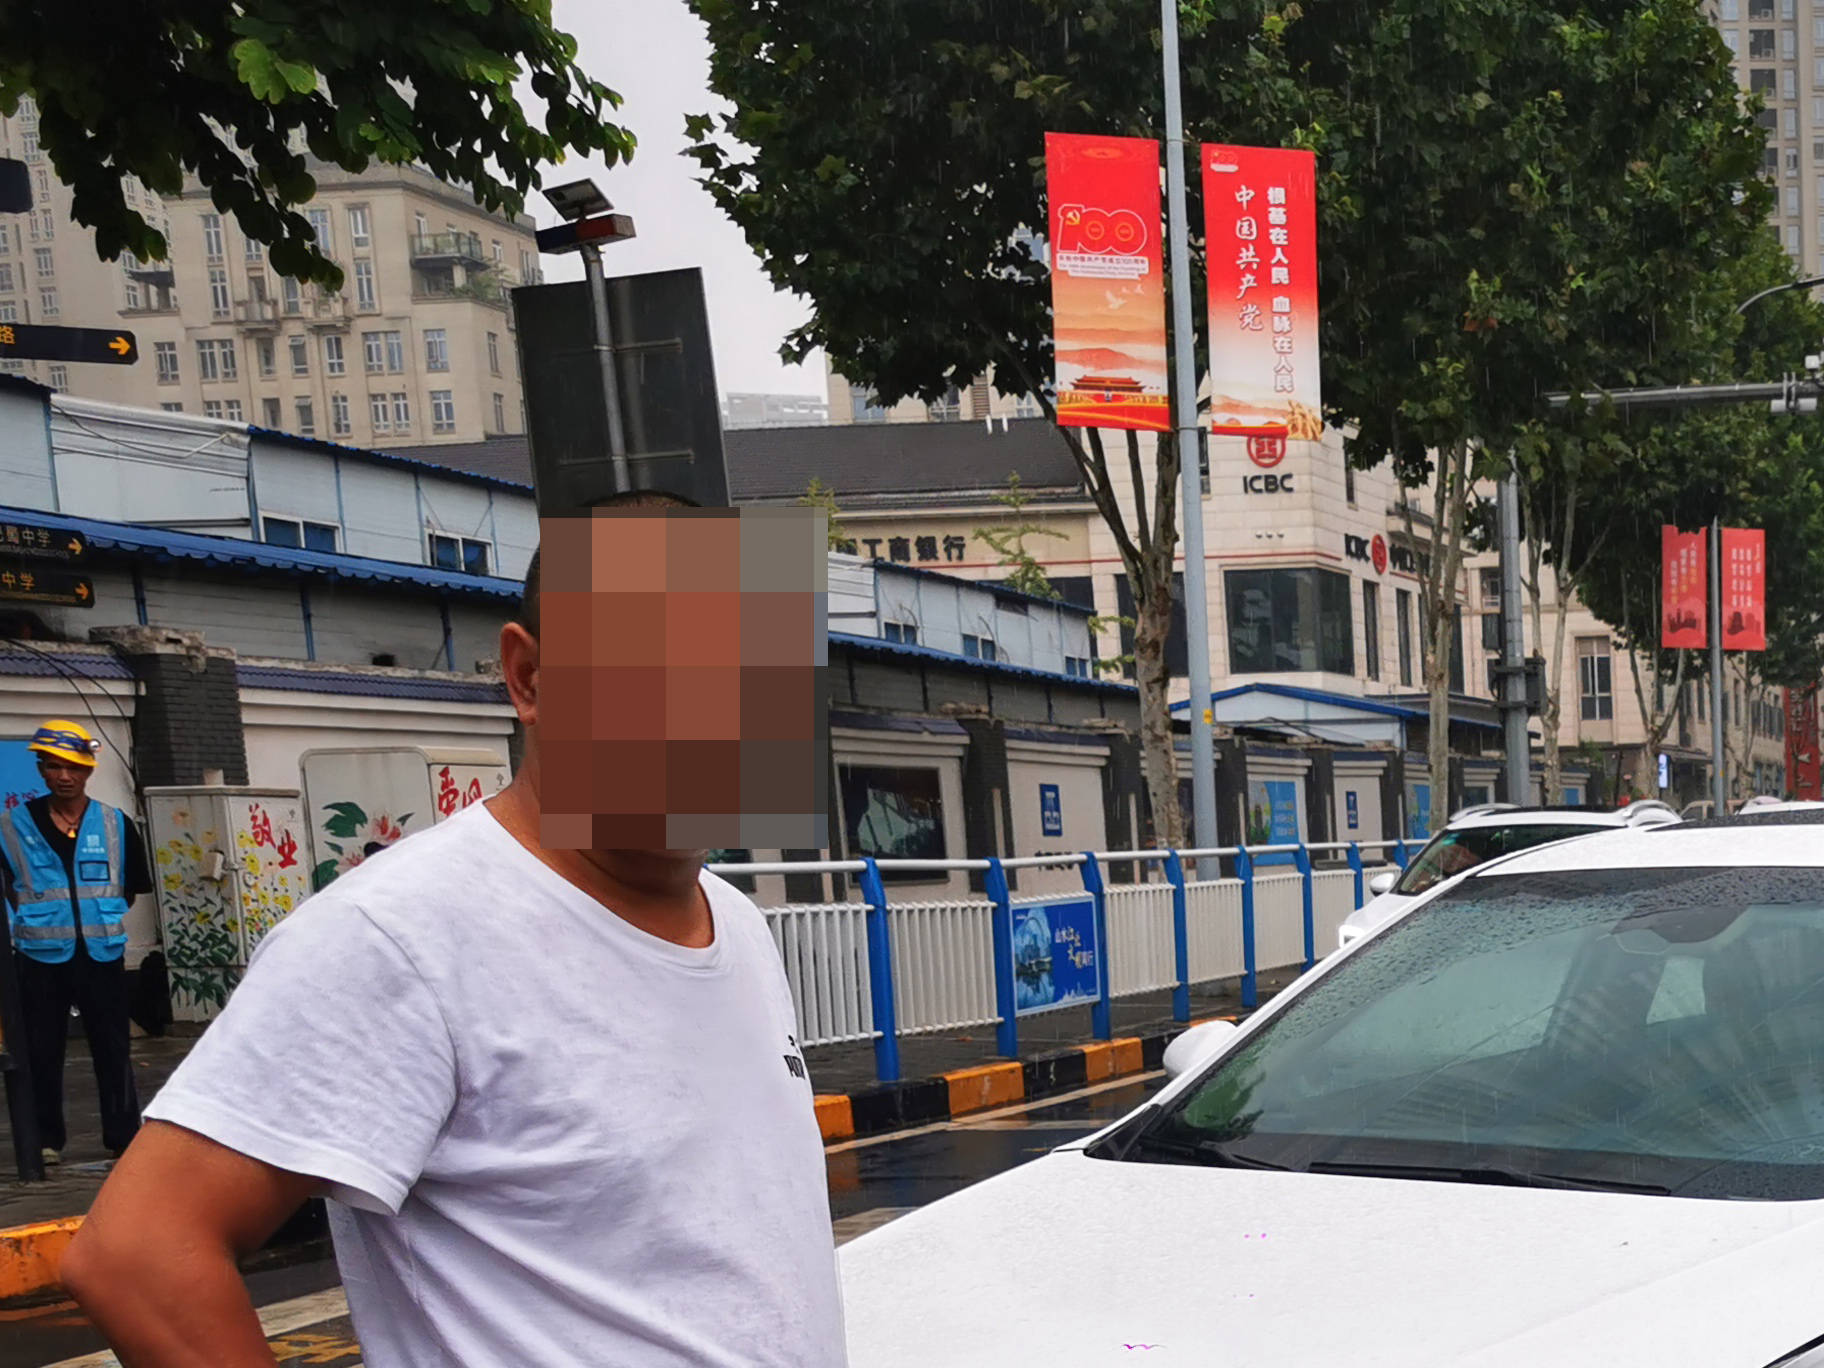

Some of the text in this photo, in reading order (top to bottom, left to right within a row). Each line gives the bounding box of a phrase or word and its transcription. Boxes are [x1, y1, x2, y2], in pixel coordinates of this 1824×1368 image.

[1234, 184, 1263, 330] 中国共产党
[1267, 186, 1294, 393] 根基在人民 血脉在人民
[1243, 472, 1294, 494] ICBC
